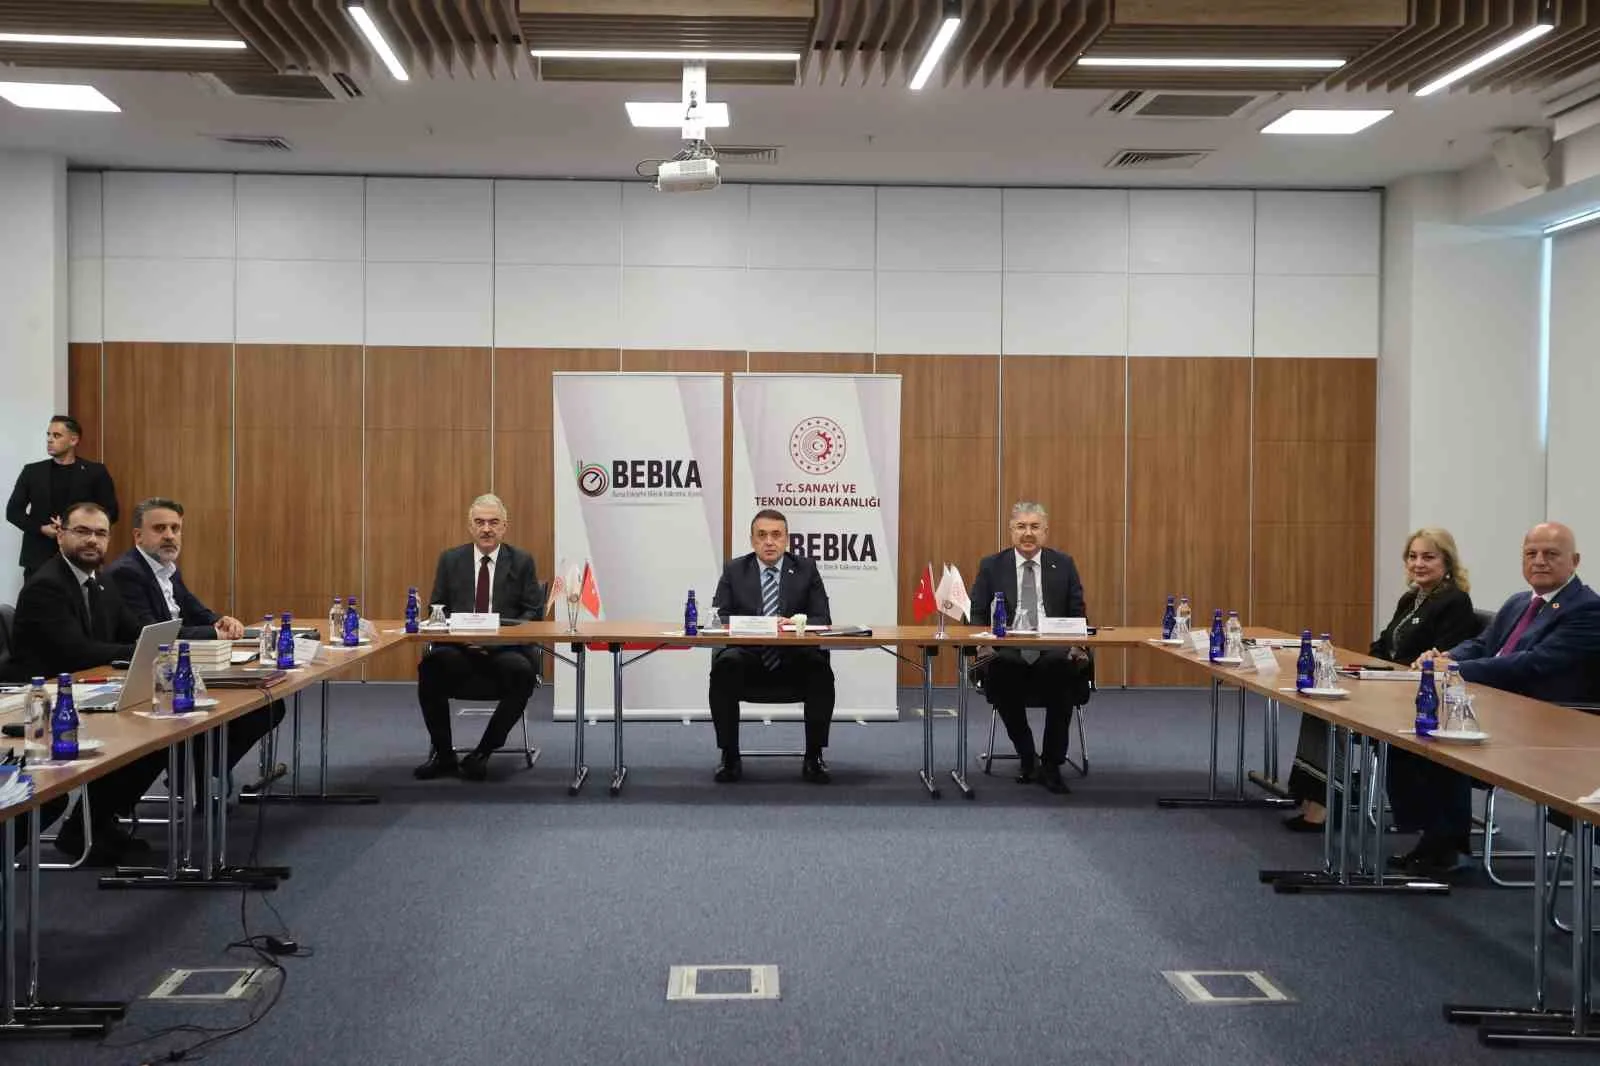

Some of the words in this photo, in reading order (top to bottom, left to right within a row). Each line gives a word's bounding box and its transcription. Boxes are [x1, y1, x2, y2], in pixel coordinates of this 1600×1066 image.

[612, 460, 702, 489] BEBKA
[776, 483, 796, 493] T.C.
[799, 481, 839, 493] SANAYİ
[842, 484, 857, 493] VE
[754, 495, 816, 506] TEKNOLOJİ
[819, 495, 881, 508] BAKANLIĞI
[789, 533, 878, 562] BEBKA
